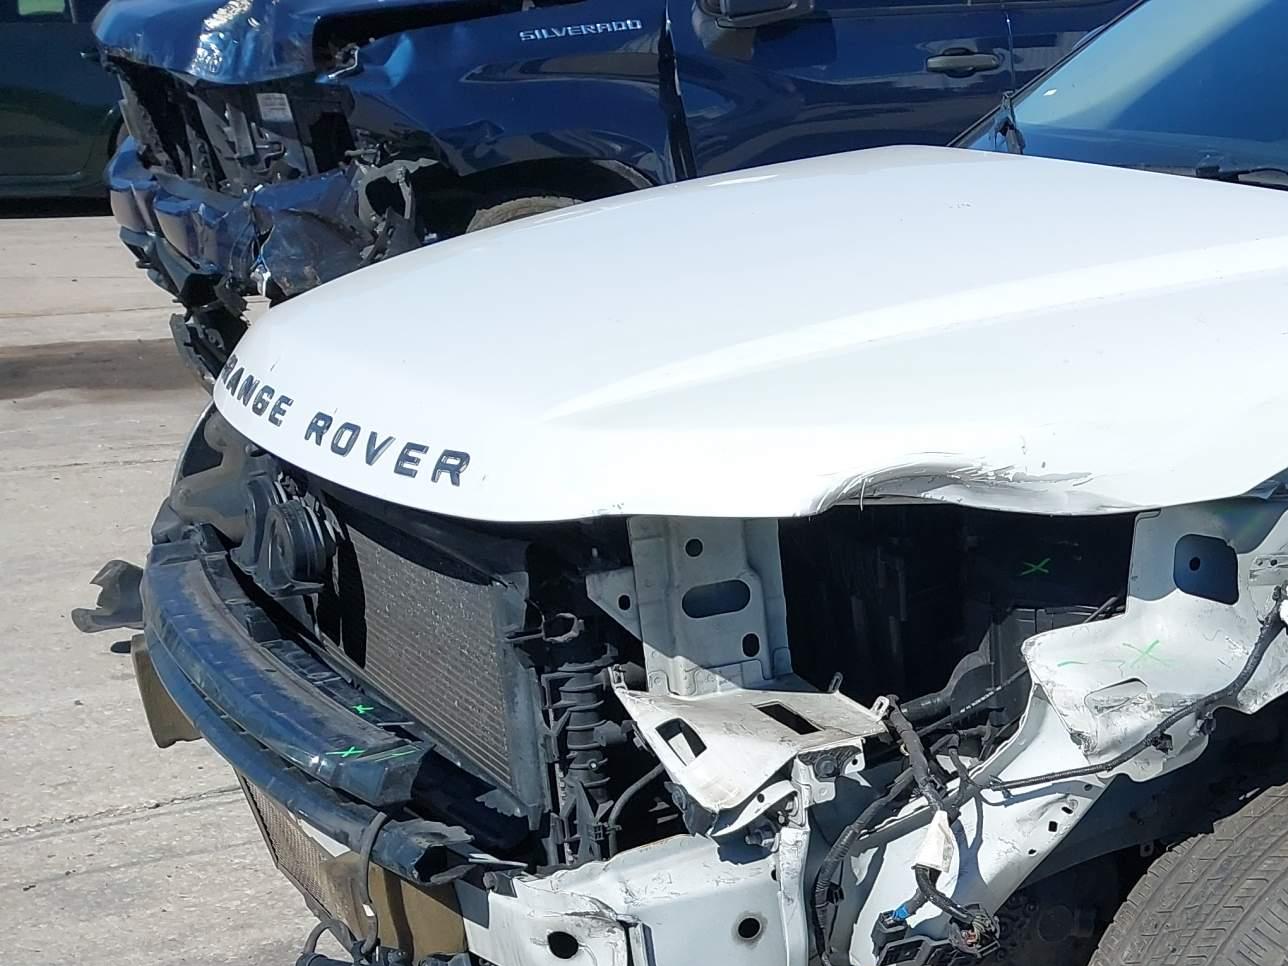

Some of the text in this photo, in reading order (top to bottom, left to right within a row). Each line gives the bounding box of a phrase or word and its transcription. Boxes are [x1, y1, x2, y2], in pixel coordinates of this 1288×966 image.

[519, 19, 643, 41] SILVERADO
[221, 353, 471, 488] RANGE ROVER
